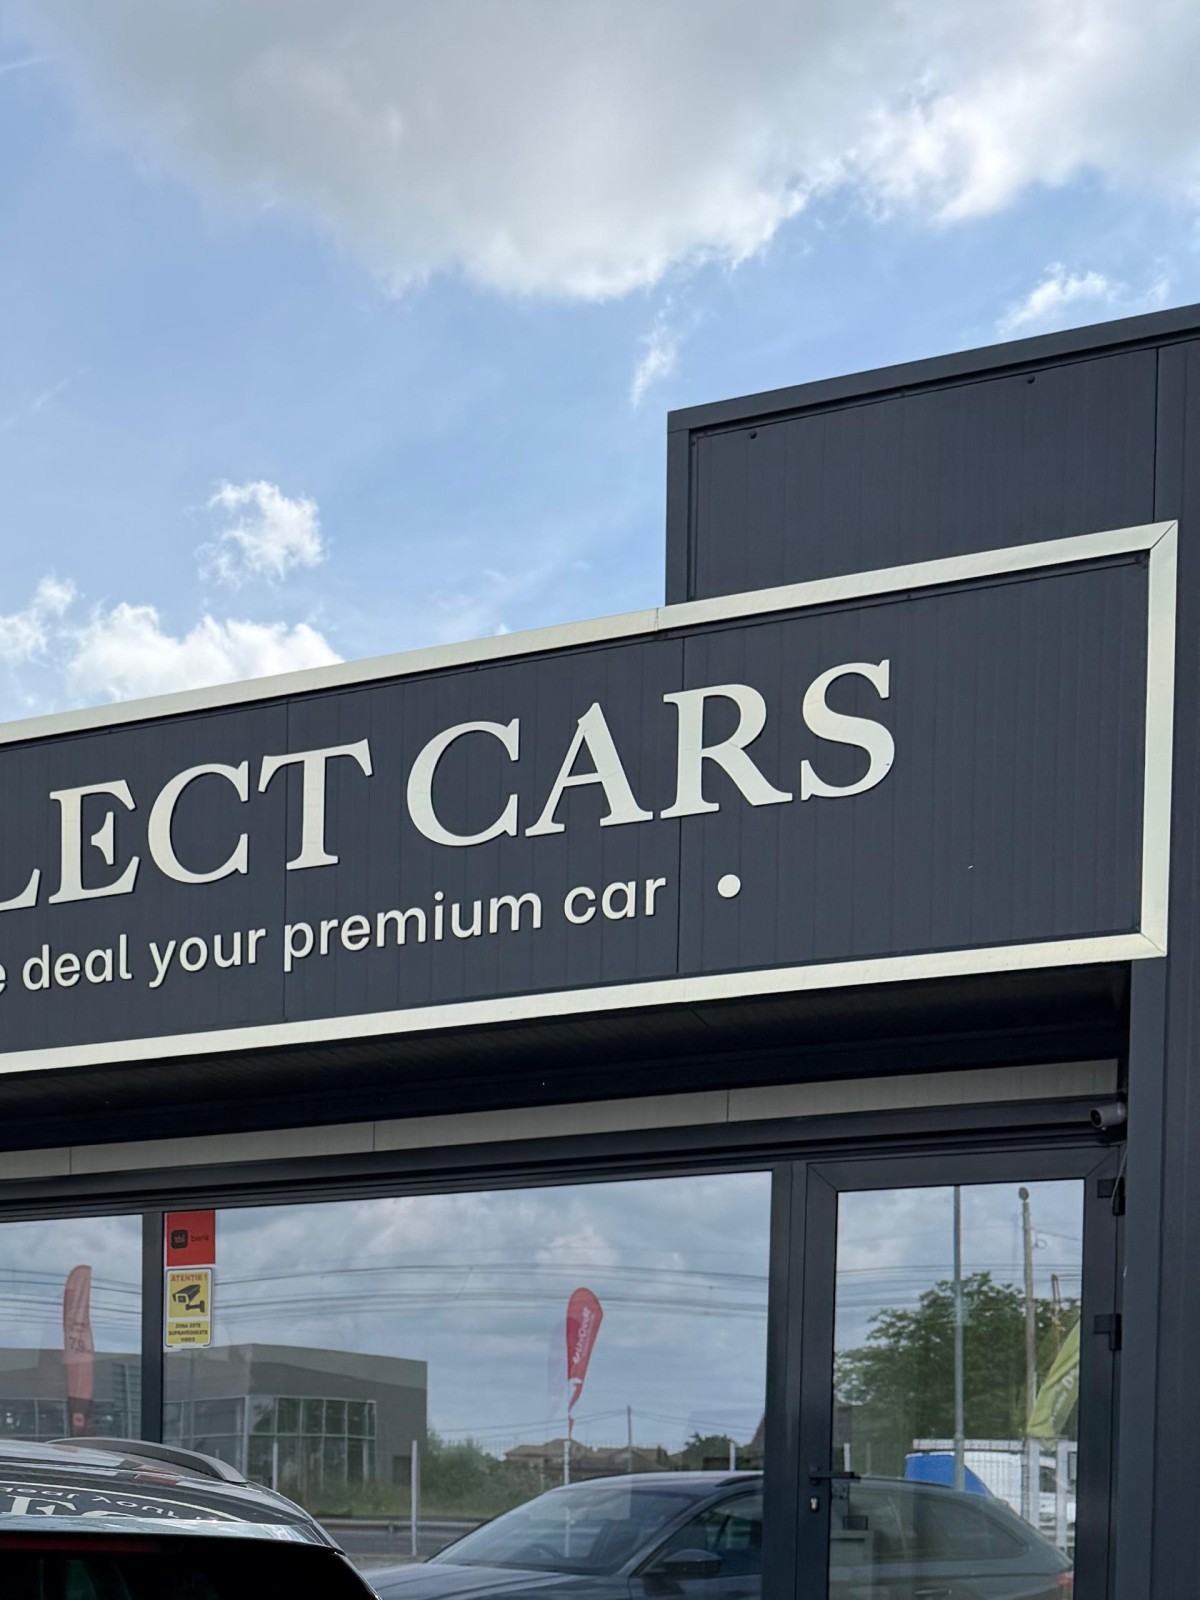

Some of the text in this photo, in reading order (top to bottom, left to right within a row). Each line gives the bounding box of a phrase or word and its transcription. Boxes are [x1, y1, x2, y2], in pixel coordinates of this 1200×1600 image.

[406, 658, 896, 847] CARS
[22, 934, 133, 991] deal
[148, 927, 267, 988] your
[282, 892, 542, 973] premium
[563, 876, 667, 926] car
